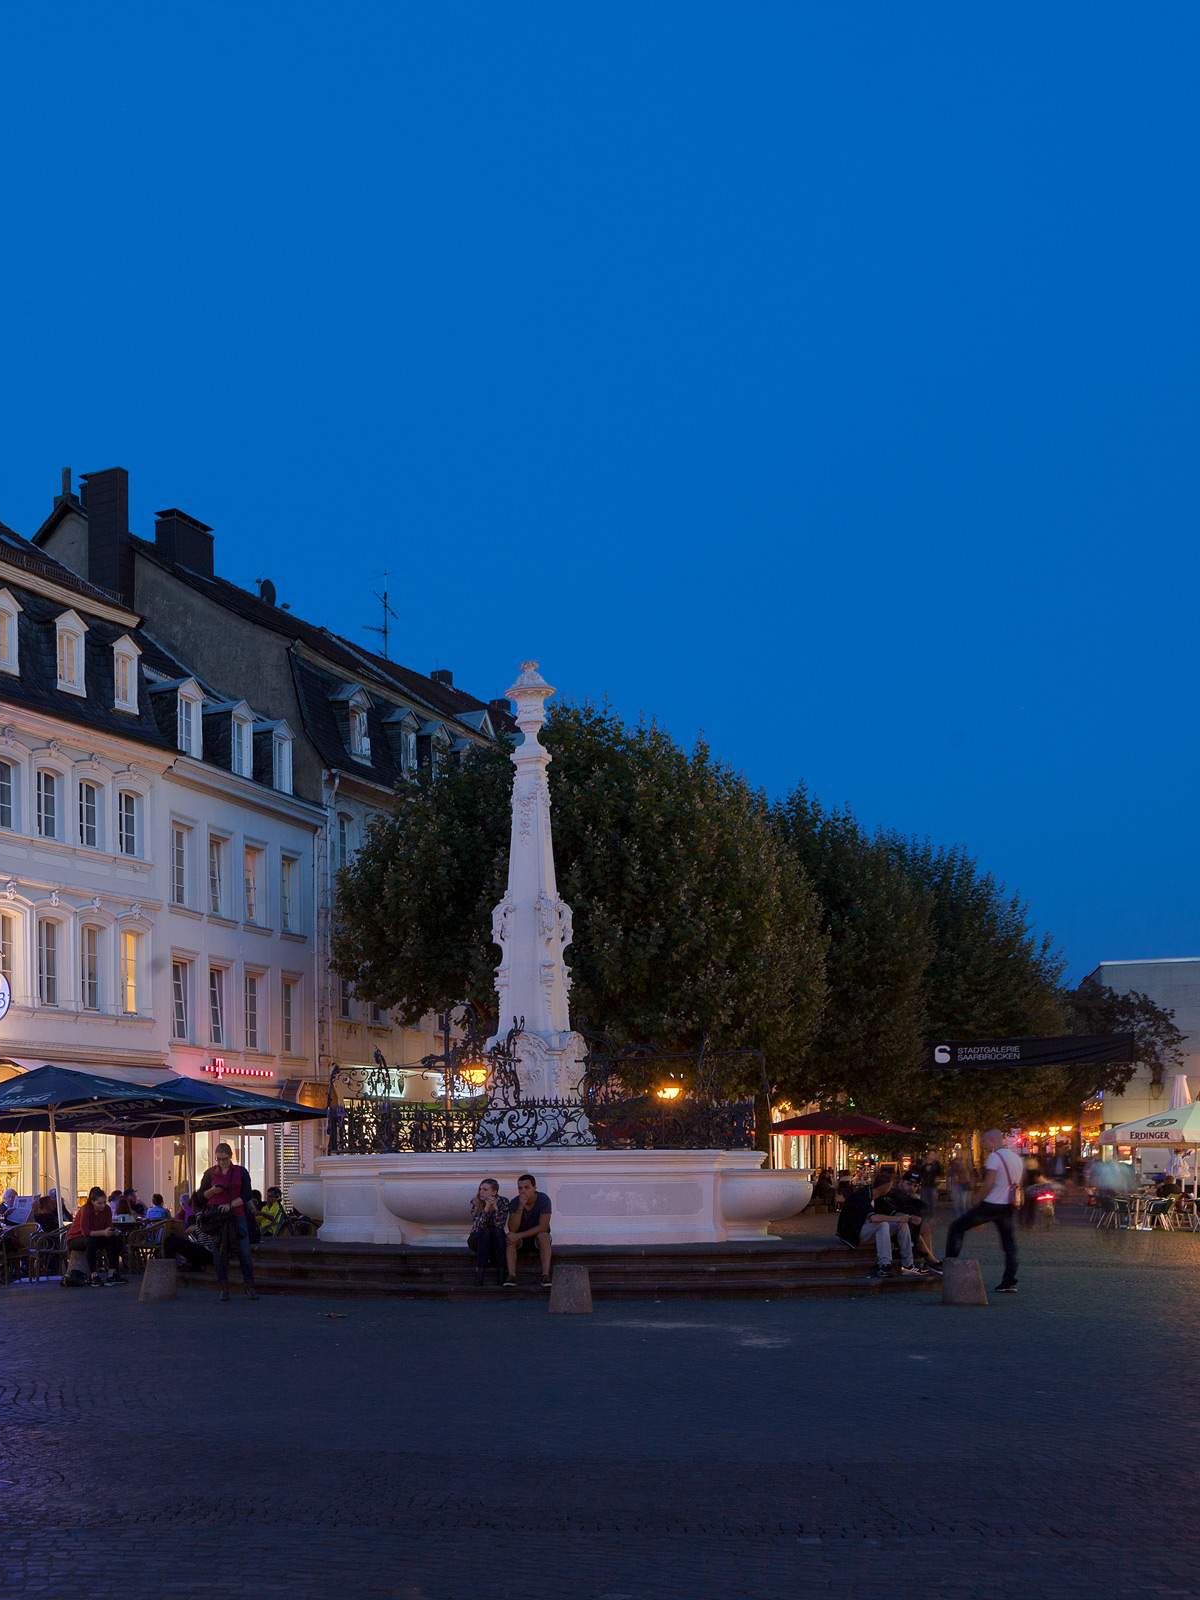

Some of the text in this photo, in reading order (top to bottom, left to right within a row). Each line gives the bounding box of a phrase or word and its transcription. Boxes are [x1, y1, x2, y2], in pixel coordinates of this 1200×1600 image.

[957, 1045, 1020, 1054] STADTGALERIE
[957, 1052, 1020, 1061] SAARBRÜCKEN
[1129, 1131, 1170, 1140] ERDINGER
